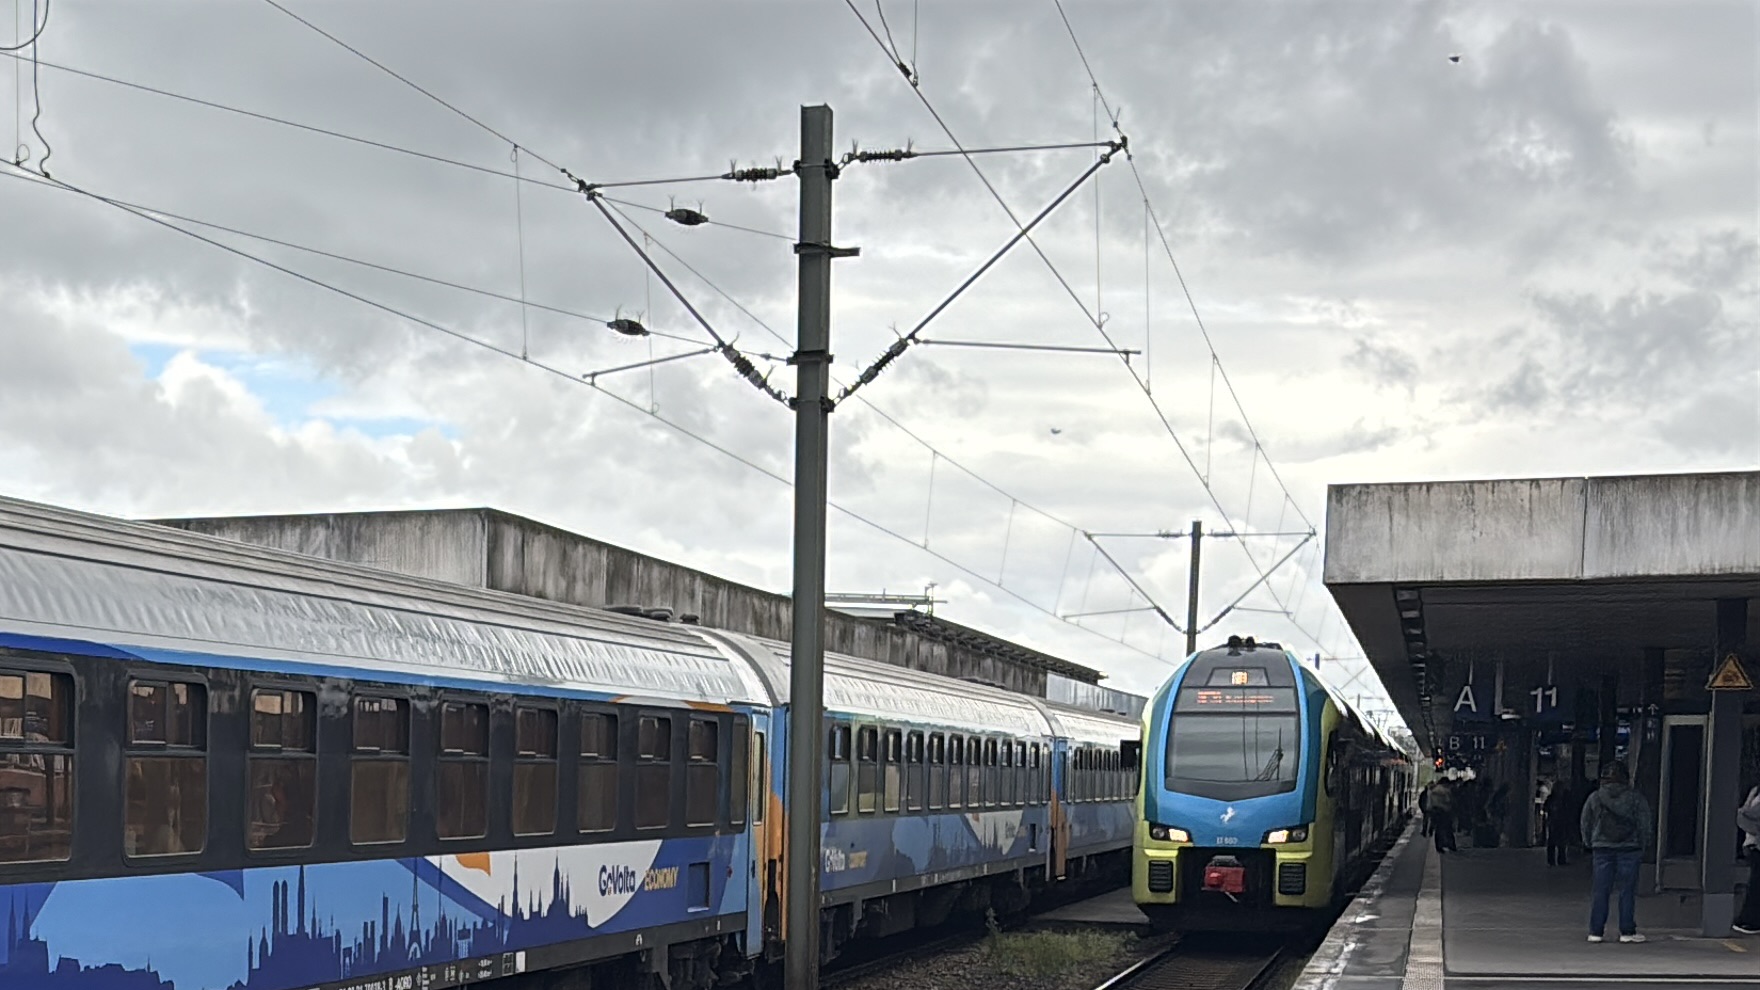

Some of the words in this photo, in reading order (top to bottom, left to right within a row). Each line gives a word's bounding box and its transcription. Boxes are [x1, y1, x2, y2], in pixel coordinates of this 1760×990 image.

[1453, 685, 1477, 713] A
[1530, 686, 1557, 713] 11
[1449, 736, 1460, 750] B
[598, 864, 636, 897] GoVolta
[644, 866, 679, 891] ECONOMY
